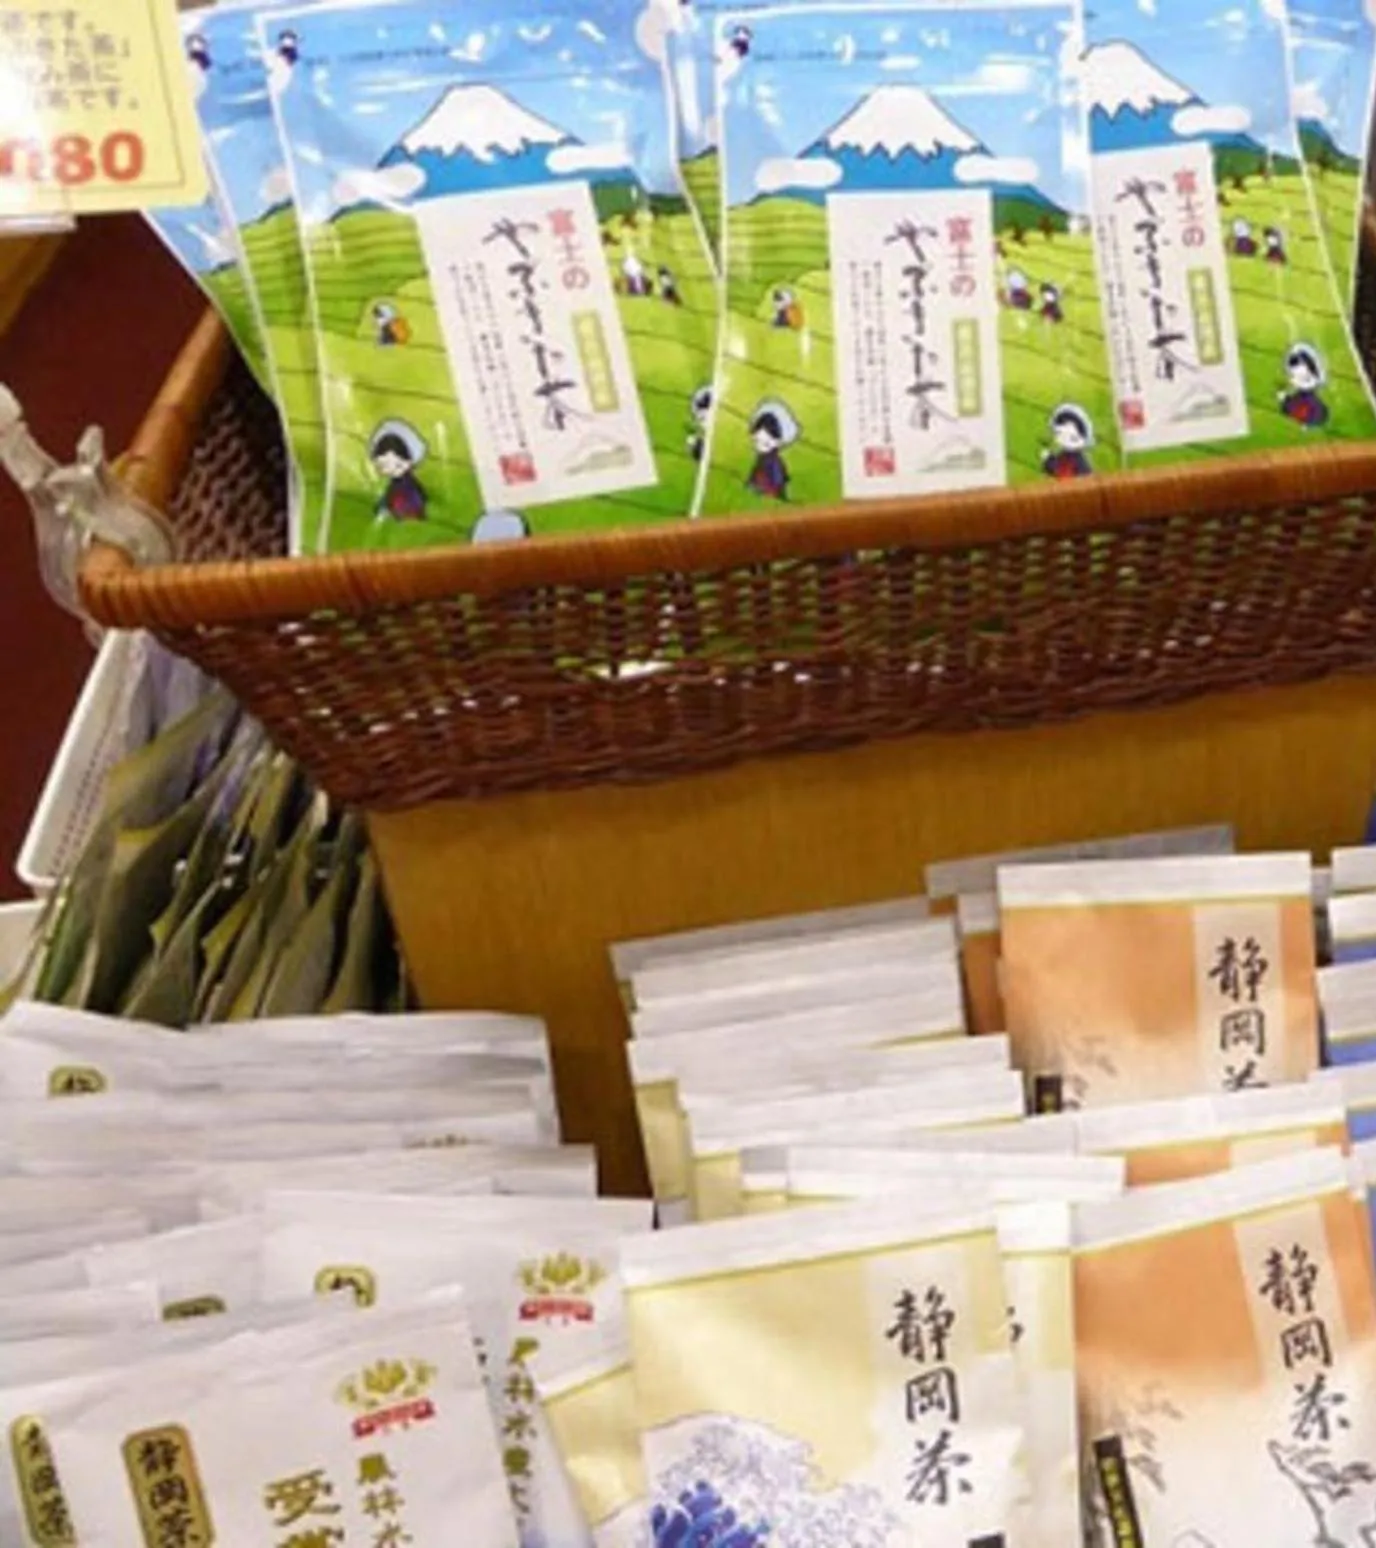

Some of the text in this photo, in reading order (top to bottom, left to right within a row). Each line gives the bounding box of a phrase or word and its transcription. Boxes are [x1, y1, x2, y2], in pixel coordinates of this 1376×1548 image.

[885, 1285, 973, 1503] 静岡茶
[1260, 1243, 1351, 1441] 静岡茶
